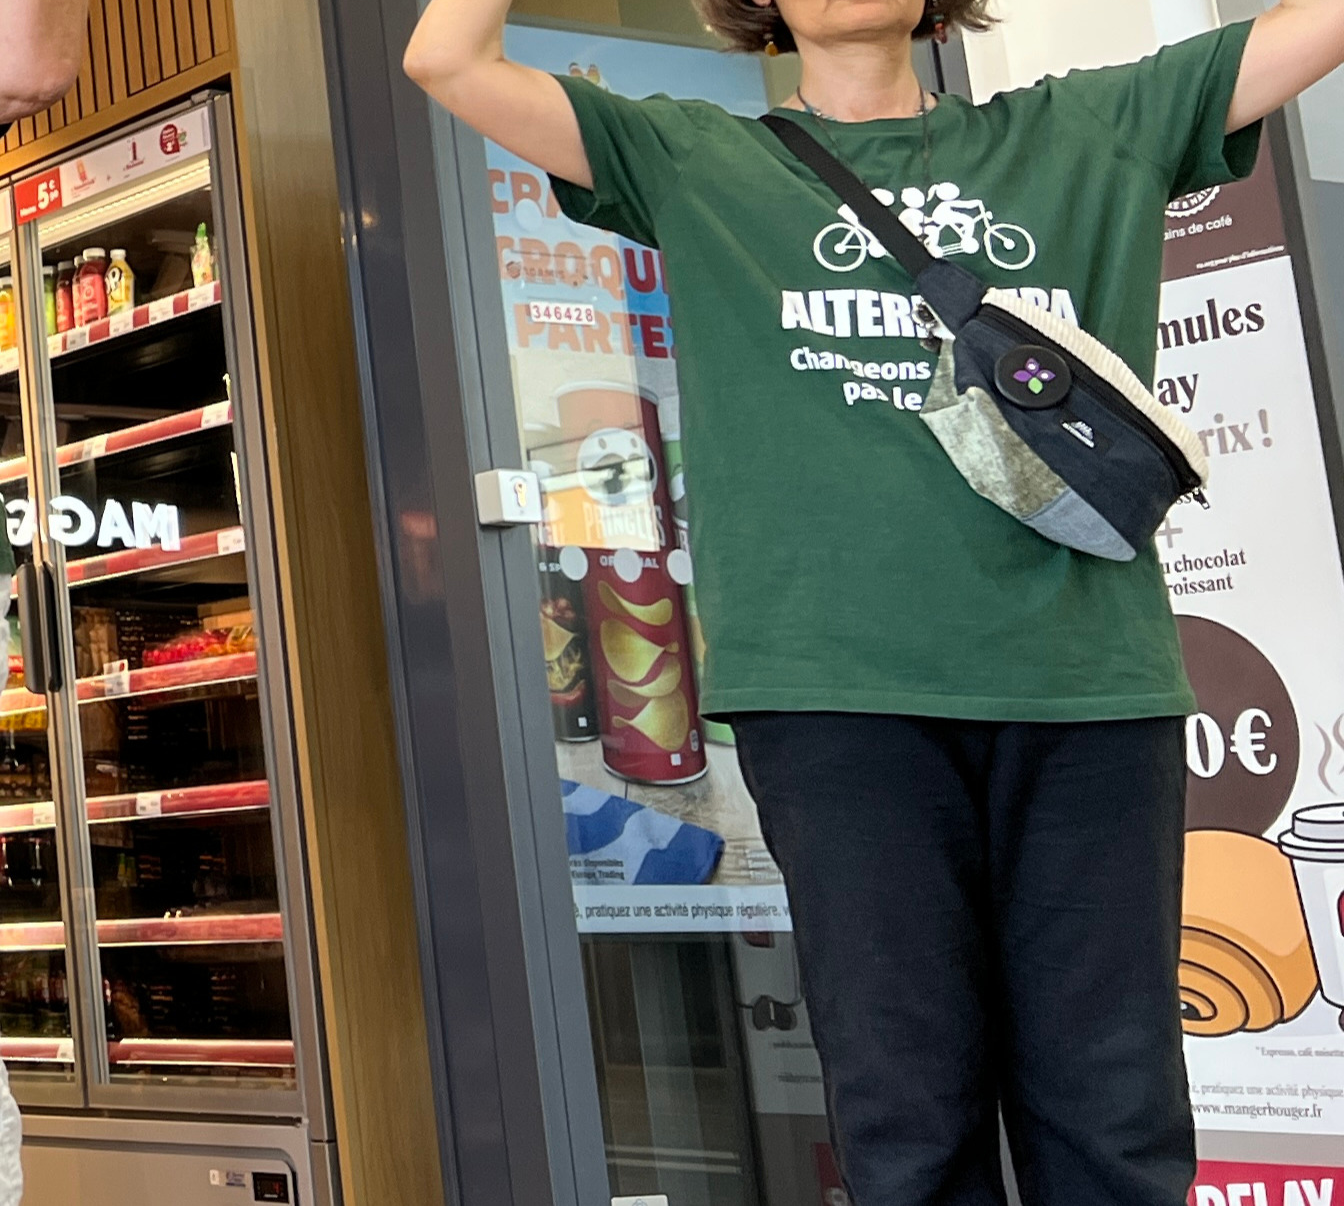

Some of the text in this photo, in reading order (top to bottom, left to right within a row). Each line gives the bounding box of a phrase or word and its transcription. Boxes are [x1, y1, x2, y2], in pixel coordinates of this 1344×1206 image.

[1188, 221, 1204, 235] de
[1206, 214, 1232, 231] café
[532, 304, 593, 322] 346428
[892, 386, 923, 411] le
[1174, 549, 1246, 573] chocolat
[585, 903, 630, 920] pratiquez
[633, 905, 651, 917] une
[654, 902, 688, 917] activité
[691, 903, 733, 920] physique
